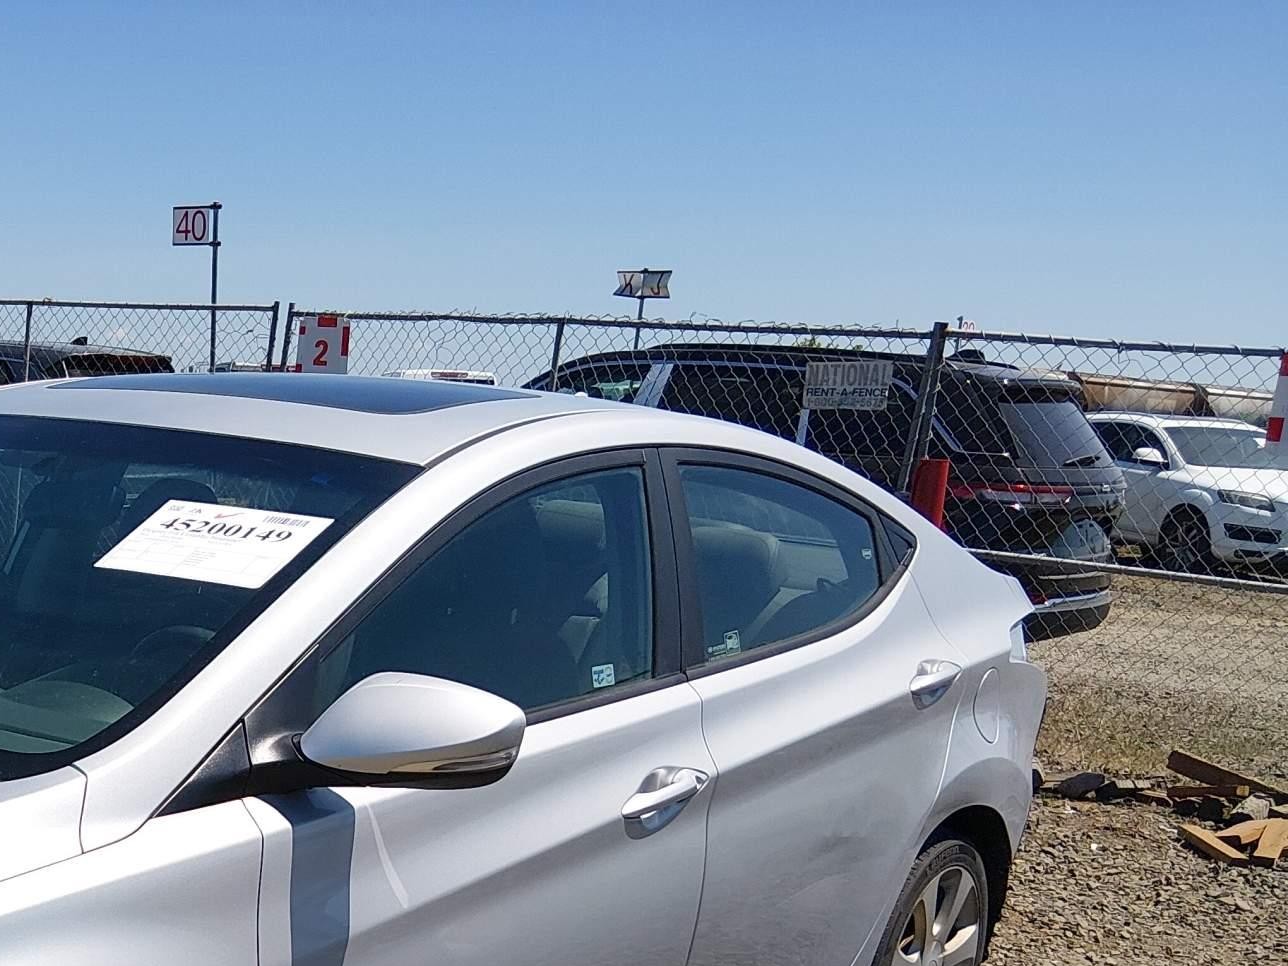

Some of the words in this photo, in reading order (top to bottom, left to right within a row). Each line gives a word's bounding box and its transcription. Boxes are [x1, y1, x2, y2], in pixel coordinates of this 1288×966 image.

[175, 210, 207, 241] 40
[620, 274, 635, 294] K
[650, 272, 665, 296] J
[313, 339, 329, 366] 2
[807, 363, 889, 386] NATIONAL
[807, 387, 888, 397] RENT-A-FENCE
[160, 517, 293, 543] 45200149
